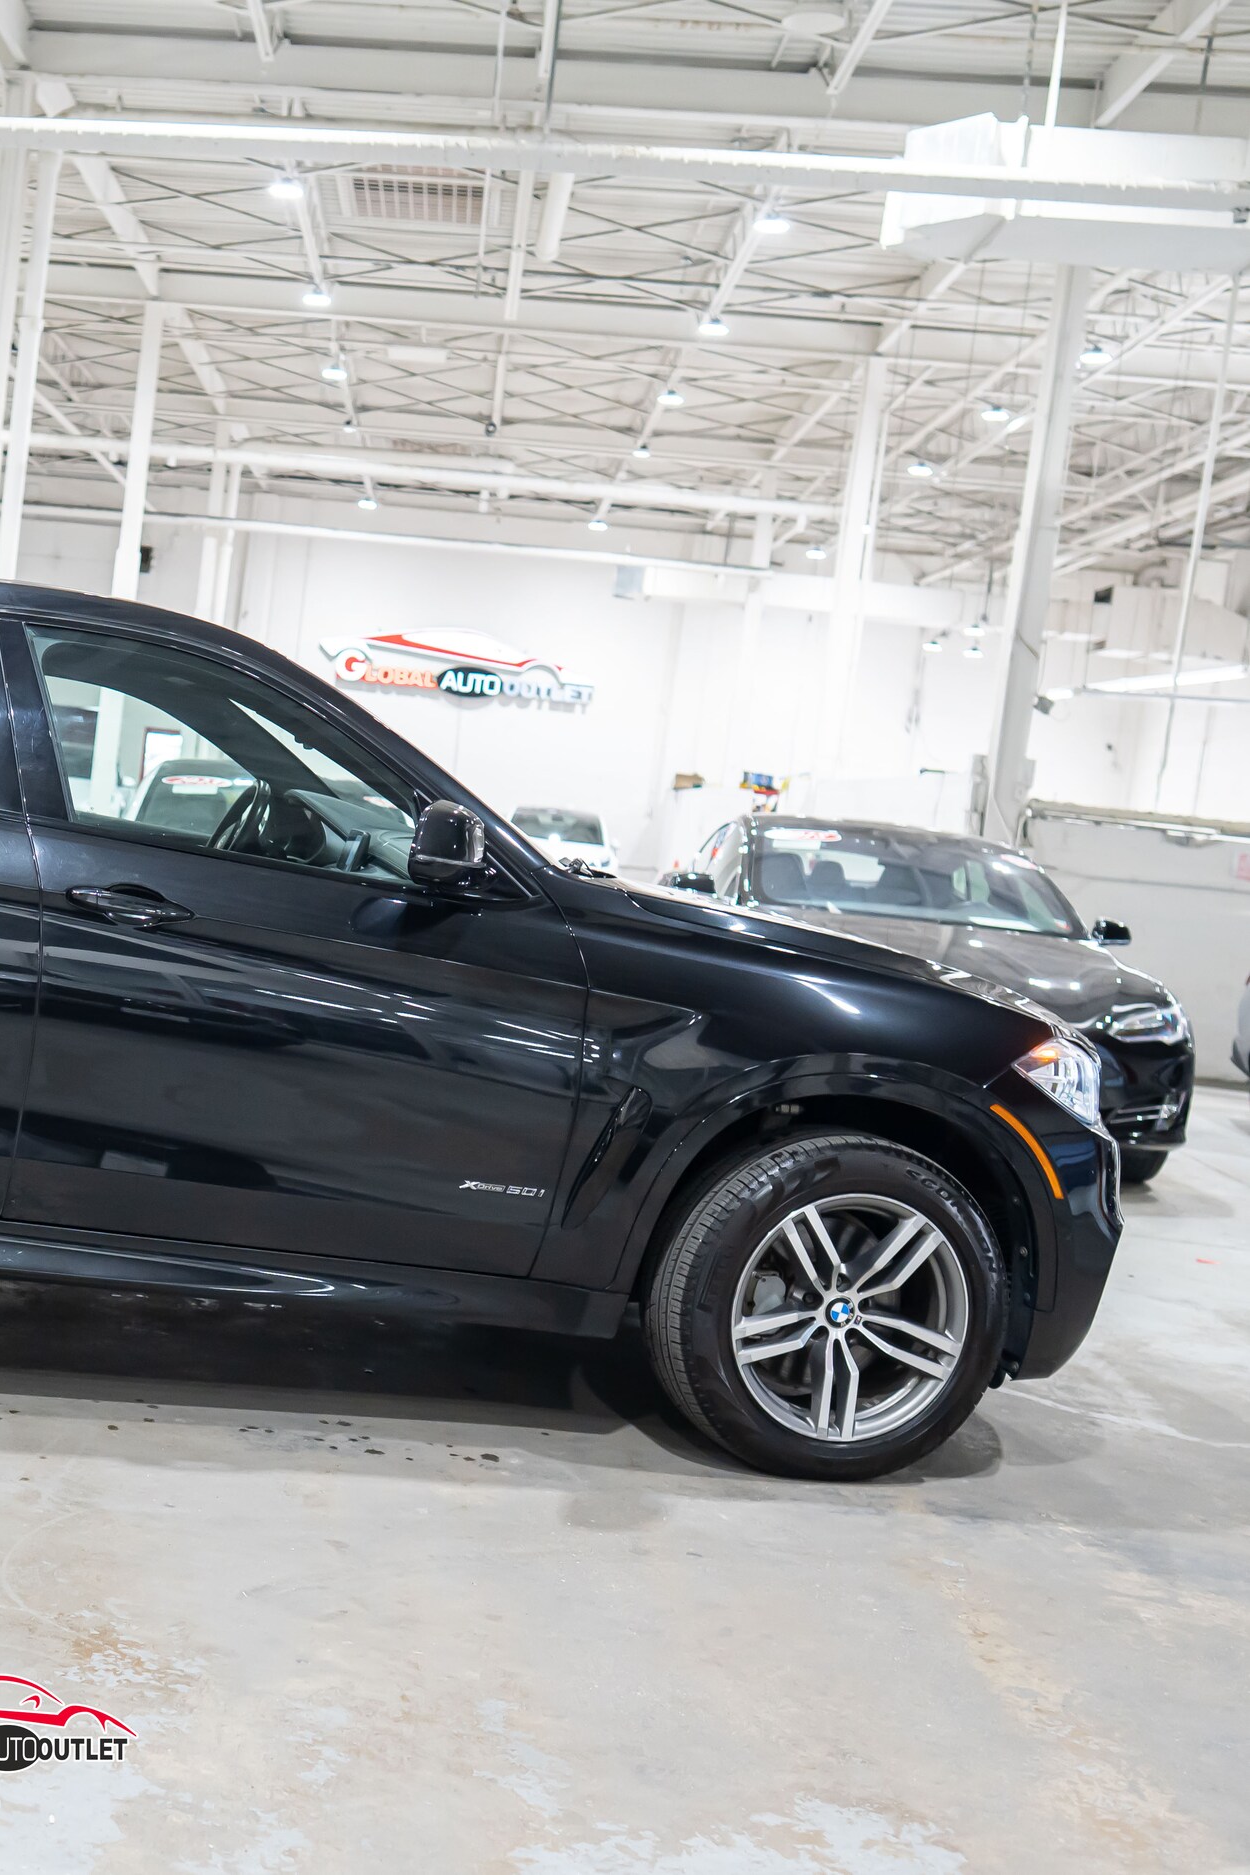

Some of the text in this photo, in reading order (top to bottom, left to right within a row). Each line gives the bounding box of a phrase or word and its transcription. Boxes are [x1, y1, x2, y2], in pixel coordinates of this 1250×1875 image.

[334, 648, 594, 704] GLOBAL AUTO OUTLET
